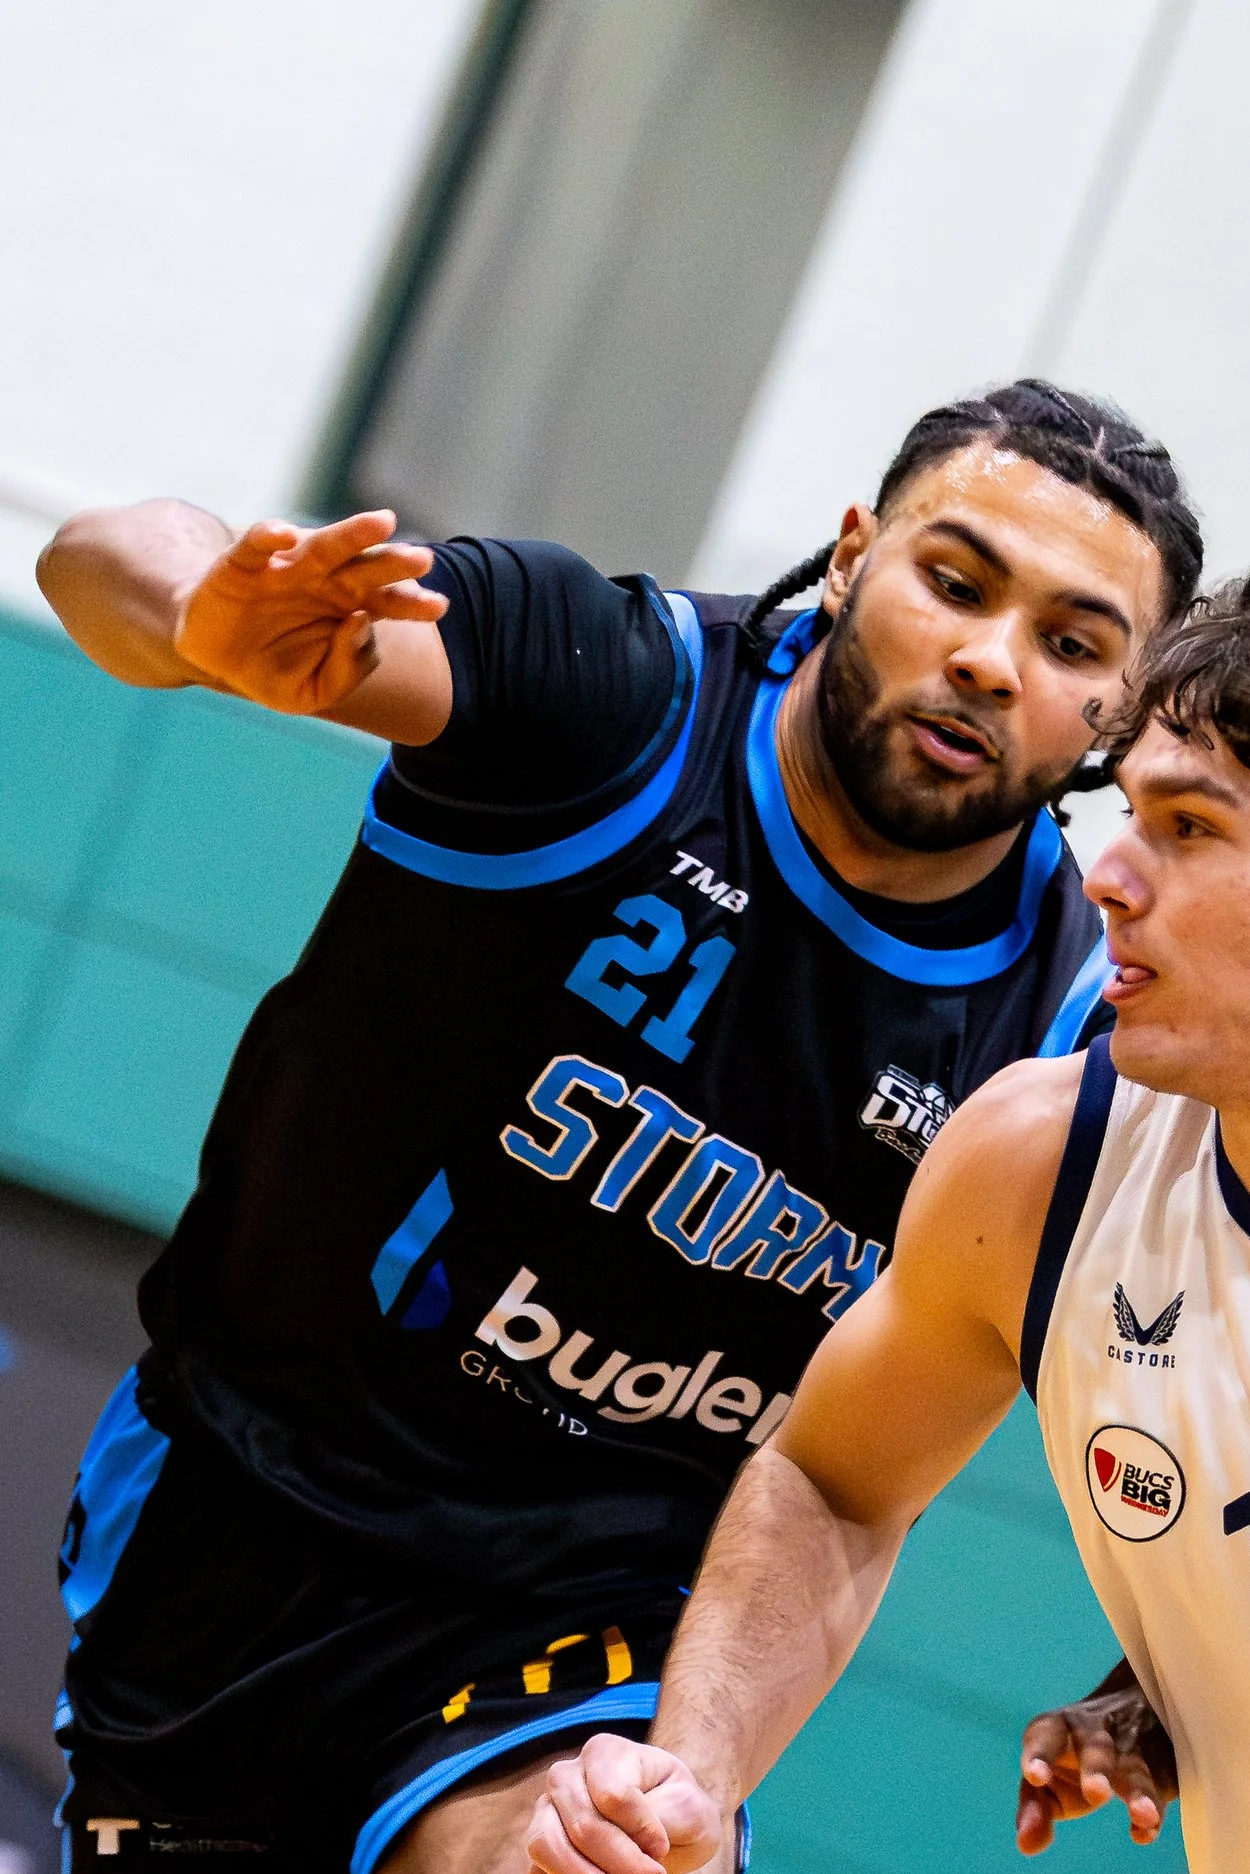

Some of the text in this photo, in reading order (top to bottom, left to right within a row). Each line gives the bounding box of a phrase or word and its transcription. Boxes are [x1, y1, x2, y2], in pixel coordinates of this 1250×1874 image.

[672, 851, 750, 915] TMB
[564, 894, 737, 1064] 21
[500, 1054, 887, 1323] STORM
[1107, 1345, 1176, 1369] CASTORE
[1121, 1478, 1172, 1511] BIG
[1123, 1463, 1175, 1491] BUCS
